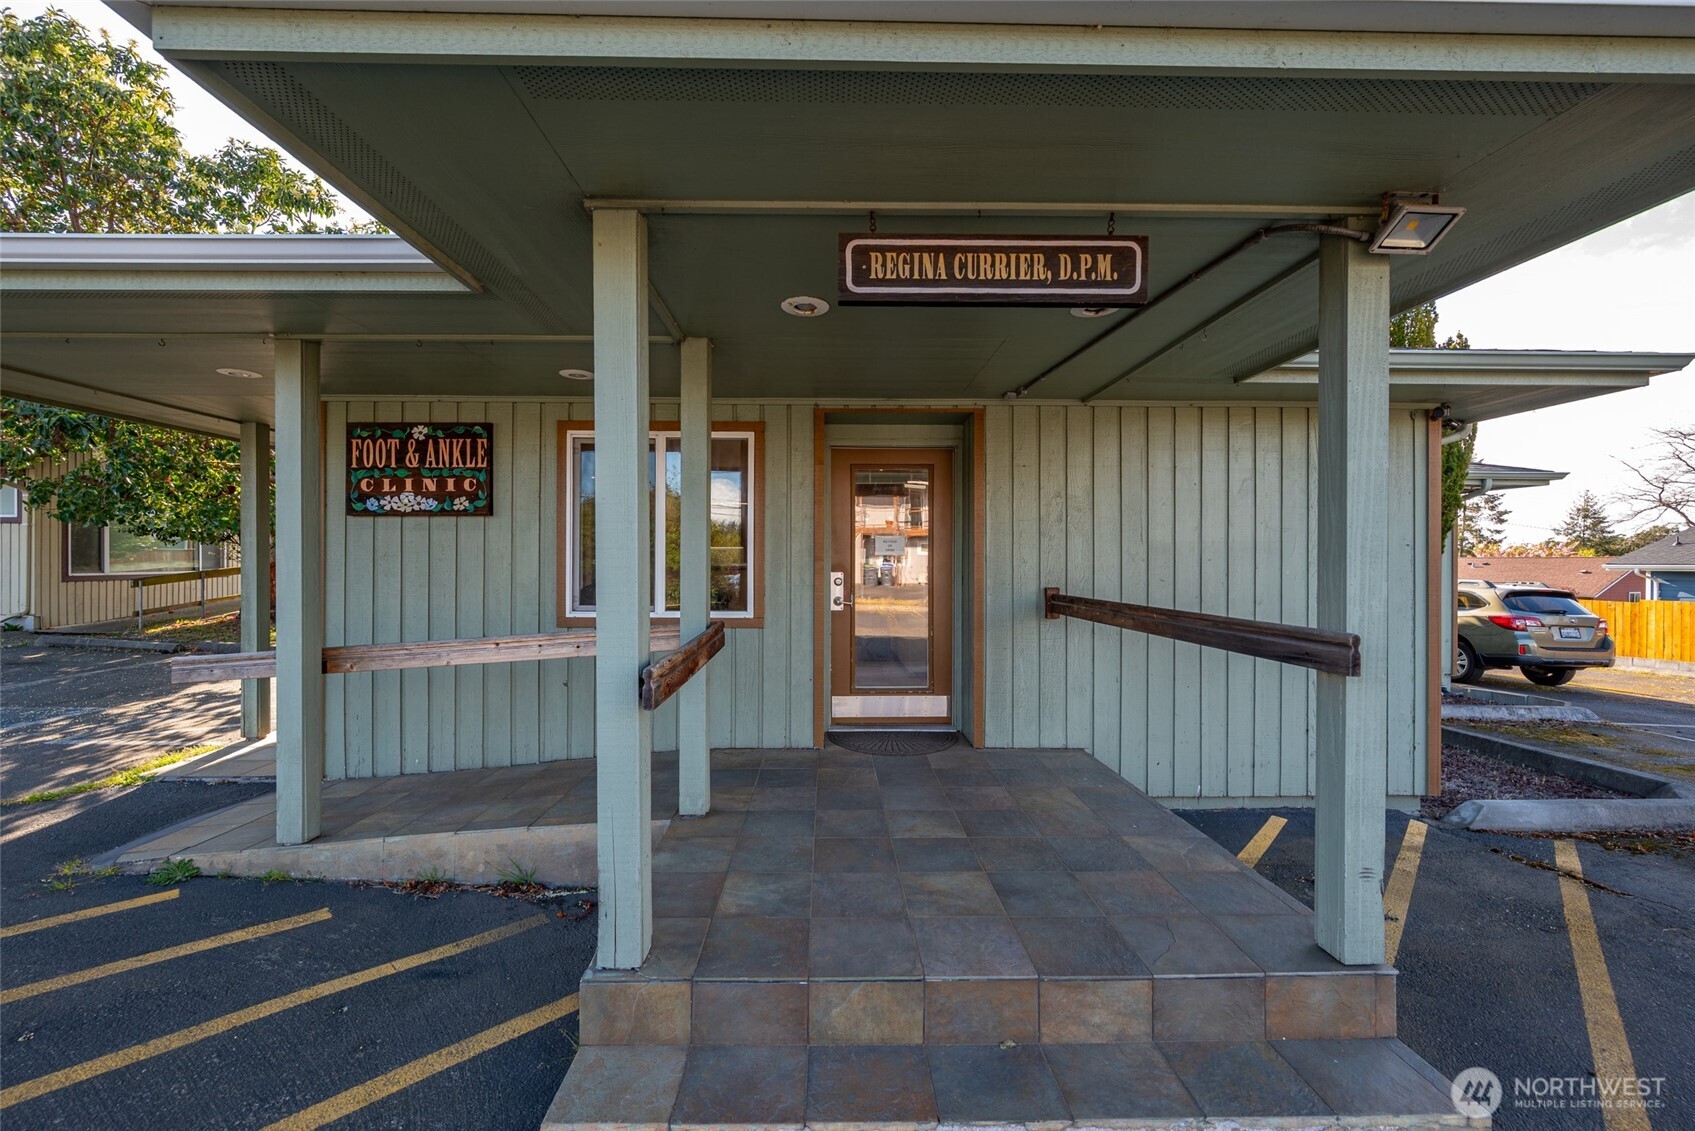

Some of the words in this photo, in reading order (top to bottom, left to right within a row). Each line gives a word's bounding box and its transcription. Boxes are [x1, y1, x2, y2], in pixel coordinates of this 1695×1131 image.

[869, 252, 948, 280] REGINA
[953, 253, 1052, 284] CURRIER,
[1058, 253, 1118, 281] D.P.M.
[351, 438, 400, 468] FOOT
[405, 438, 420, 468] &
[424, 438, 488, 468] ANKLE
[360, 478, 477, 492] CLINIC
